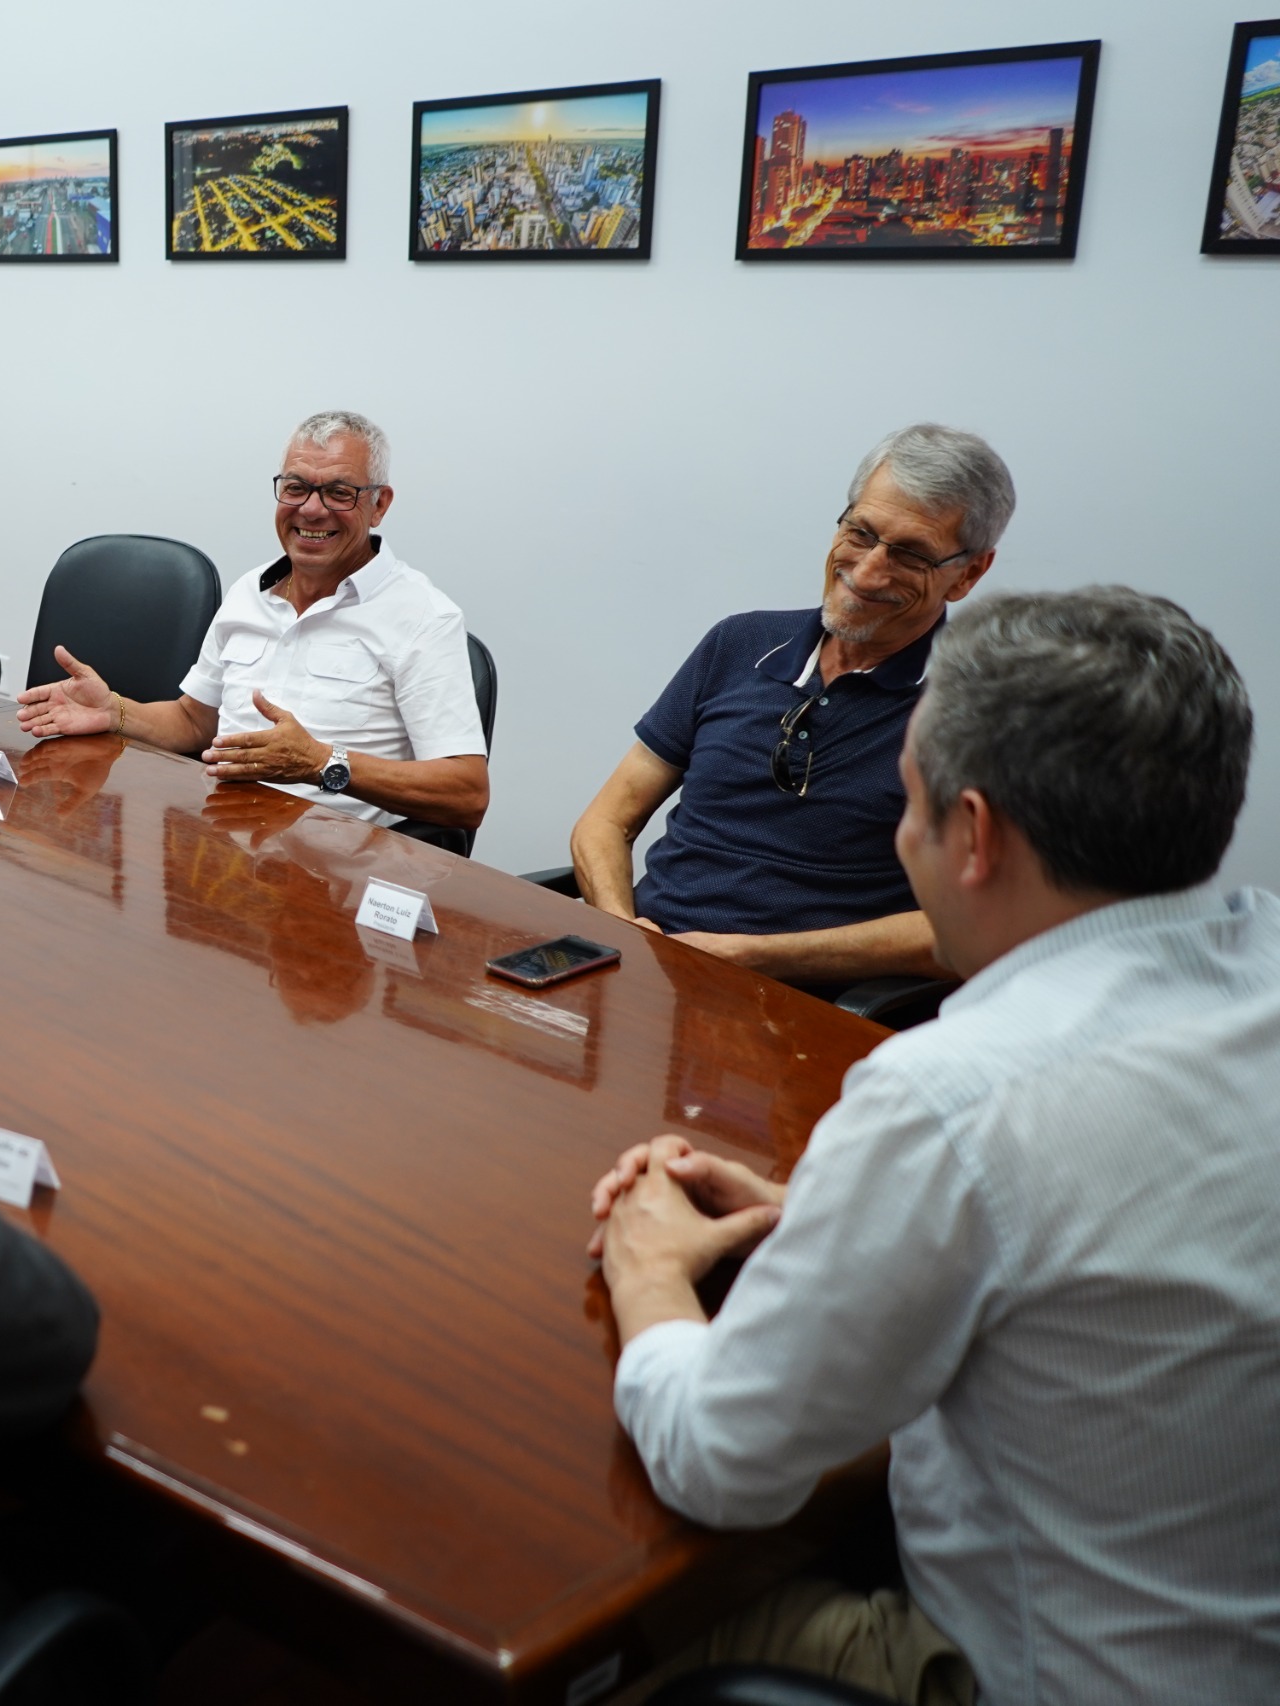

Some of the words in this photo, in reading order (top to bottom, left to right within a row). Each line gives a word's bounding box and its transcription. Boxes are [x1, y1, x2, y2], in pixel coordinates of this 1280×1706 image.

[367, 897, 395, 912] Naerton
[396, 907, 412, 918] Luiz
[374, 910, 398, 925] Rorato
